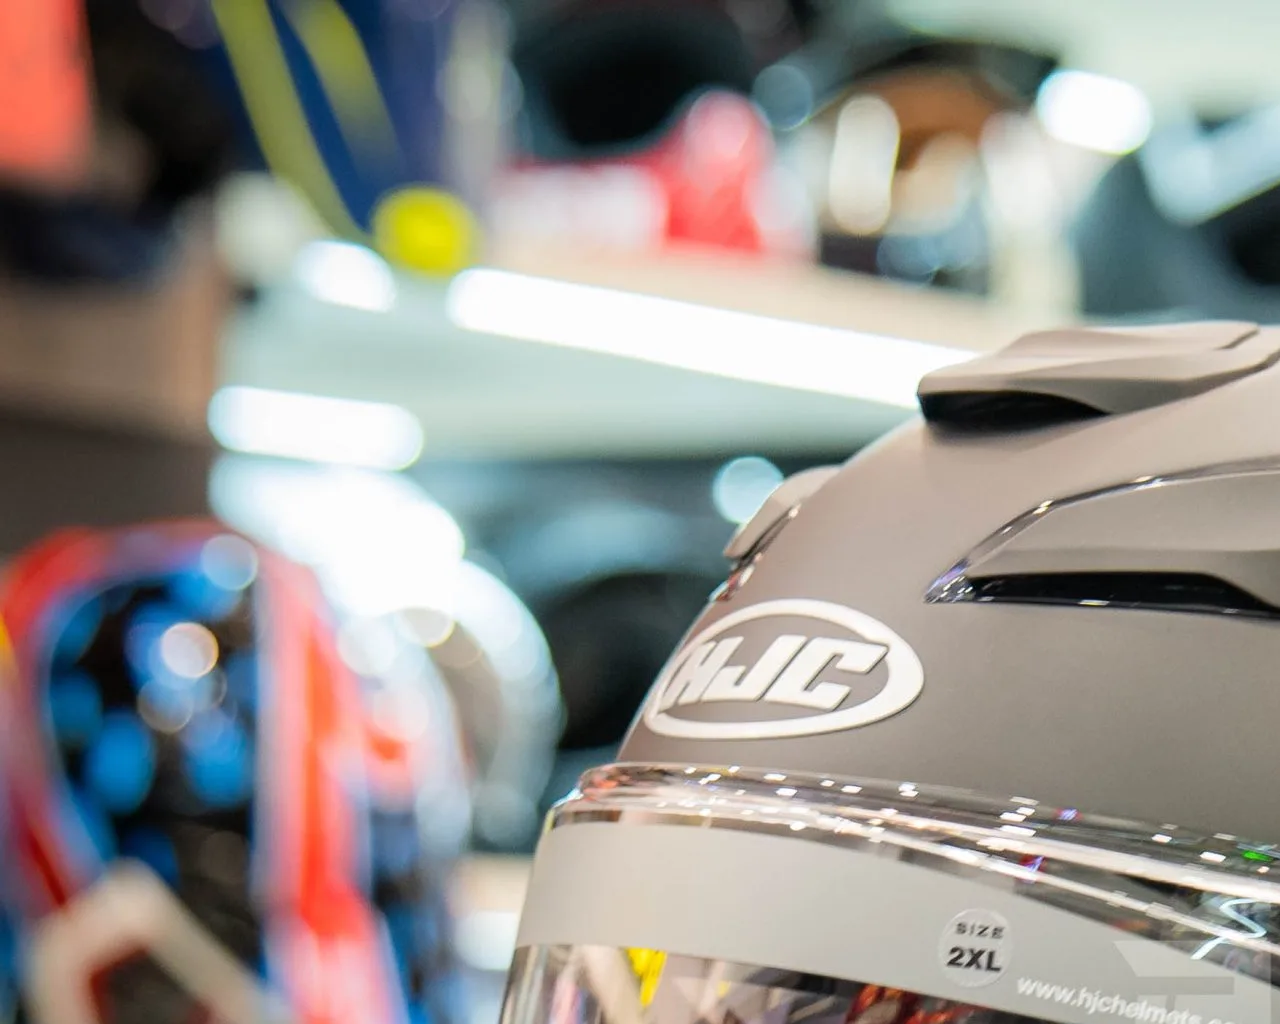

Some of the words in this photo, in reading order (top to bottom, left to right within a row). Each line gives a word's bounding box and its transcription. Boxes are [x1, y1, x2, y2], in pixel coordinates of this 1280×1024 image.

[658, 635, 889, 712] HJC
[955, 922, 1005, 940] SIZE
[947, 946, 1003, 972] 2XL
